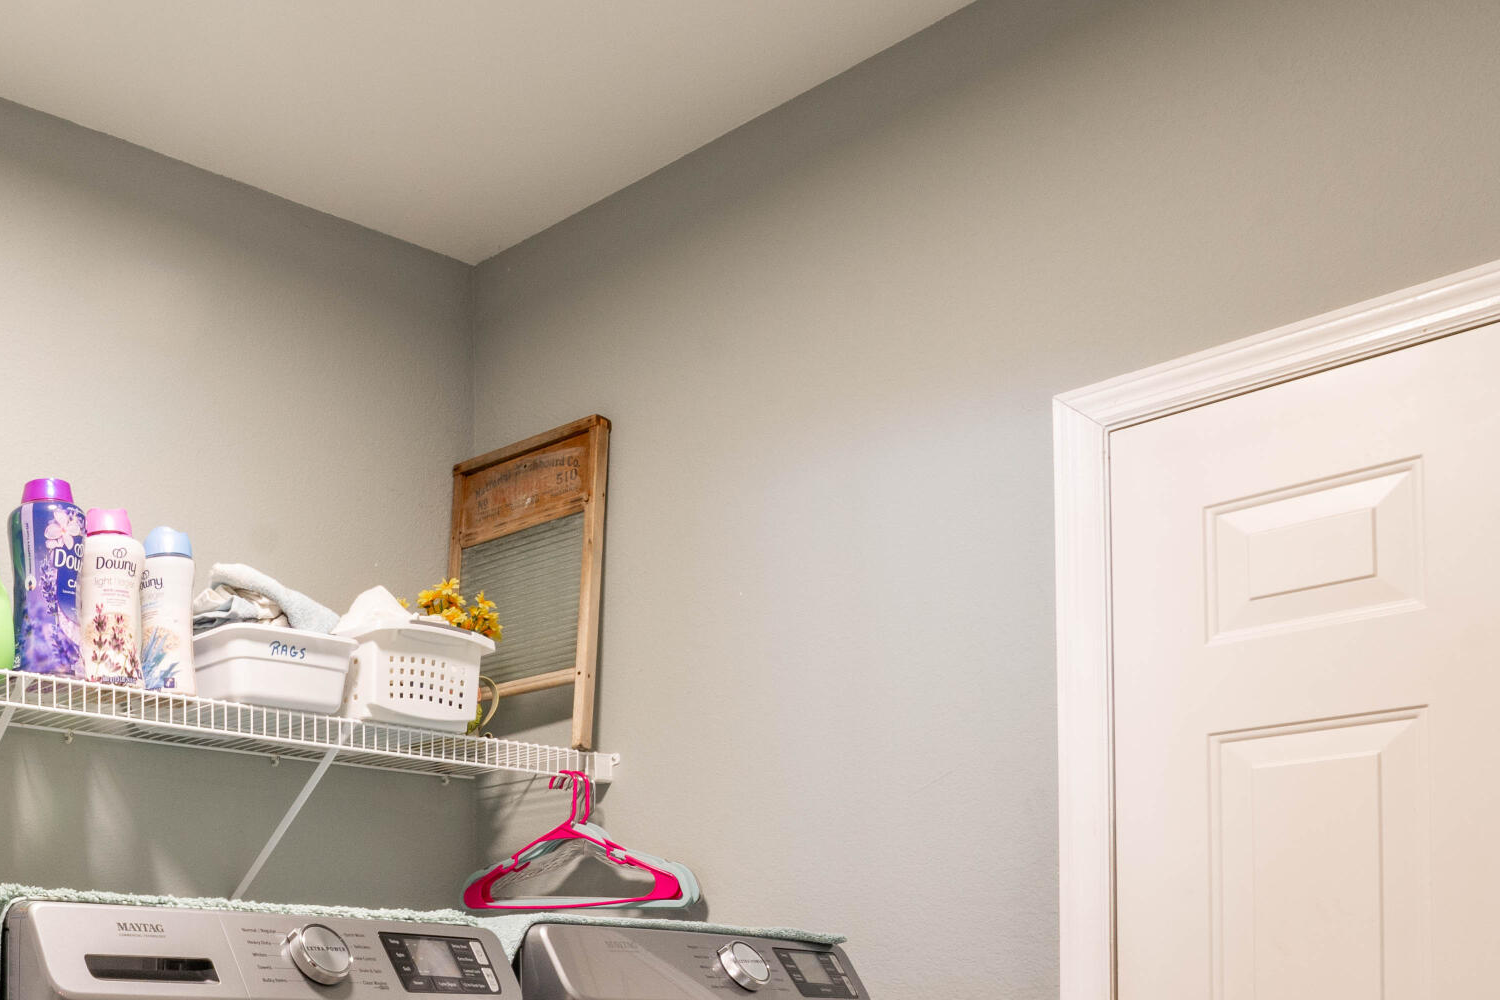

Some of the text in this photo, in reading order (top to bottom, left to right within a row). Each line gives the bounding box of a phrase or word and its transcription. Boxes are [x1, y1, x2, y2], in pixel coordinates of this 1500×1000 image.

[555, 468, 578, 485] 510
[55, 548, 82, 572] Dow
[95, 556, 137, 577] Downy
[140, 577, 164, 590] owny
[269, 640, 306, 660] RAGS
[116, 922, 165, 933] MAYTAG
